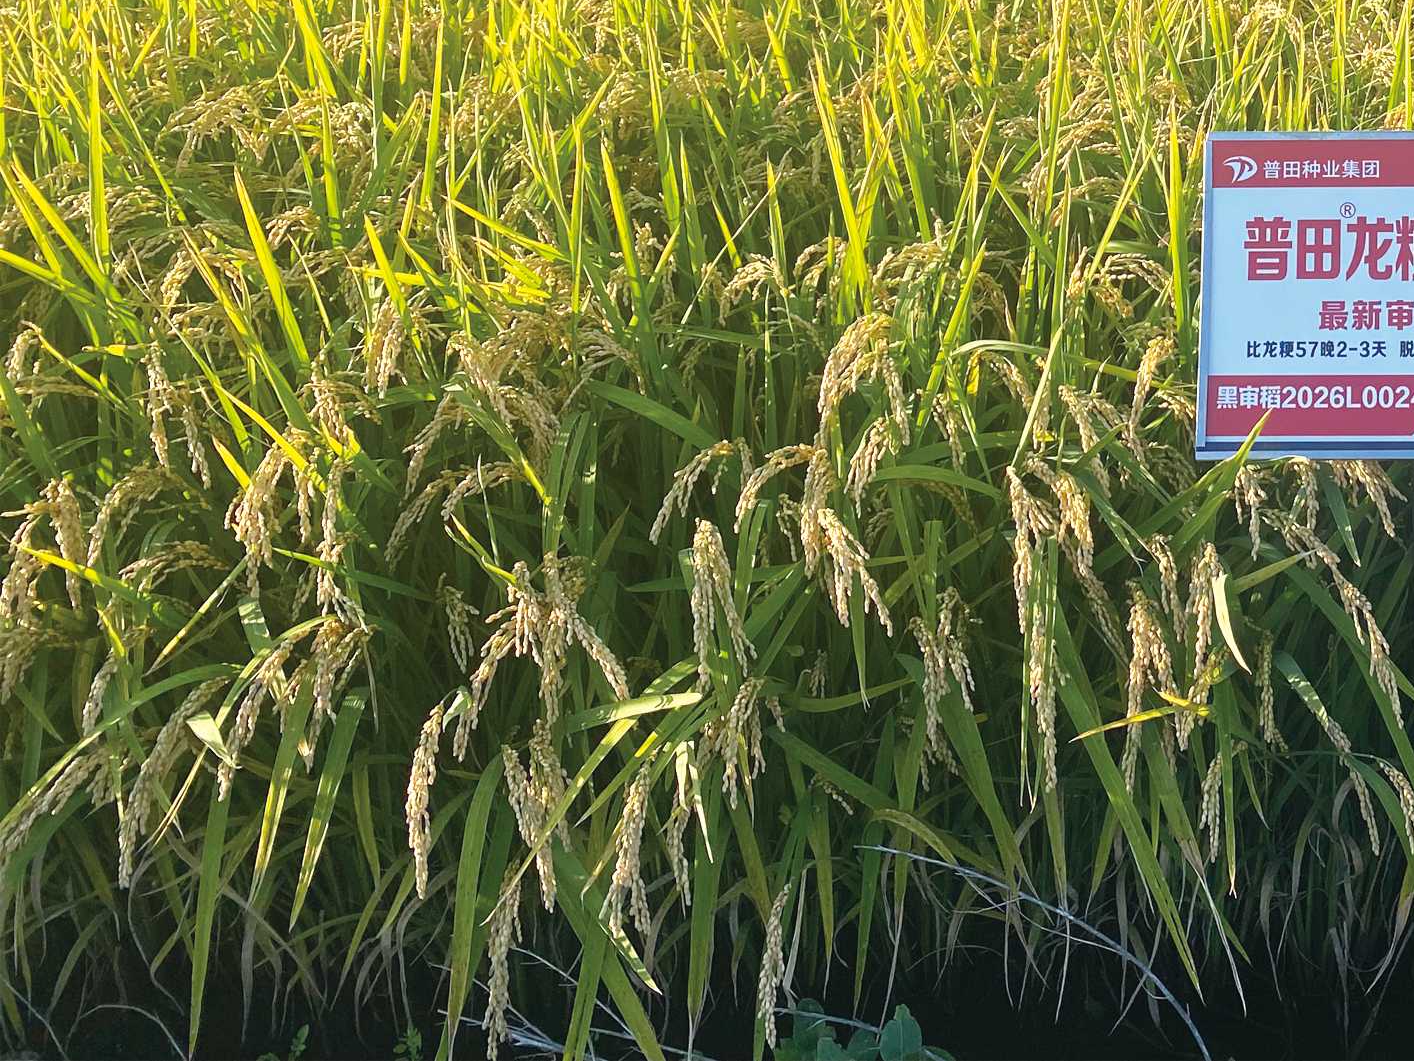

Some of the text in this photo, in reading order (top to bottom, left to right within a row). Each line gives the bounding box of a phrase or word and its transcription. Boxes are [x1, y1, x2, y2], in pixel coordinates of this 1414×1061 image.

[1263, 160, 1380, 179] 普田种业集团
[1246, 340, 1387, 358] 比龙粳57晚2-3天
